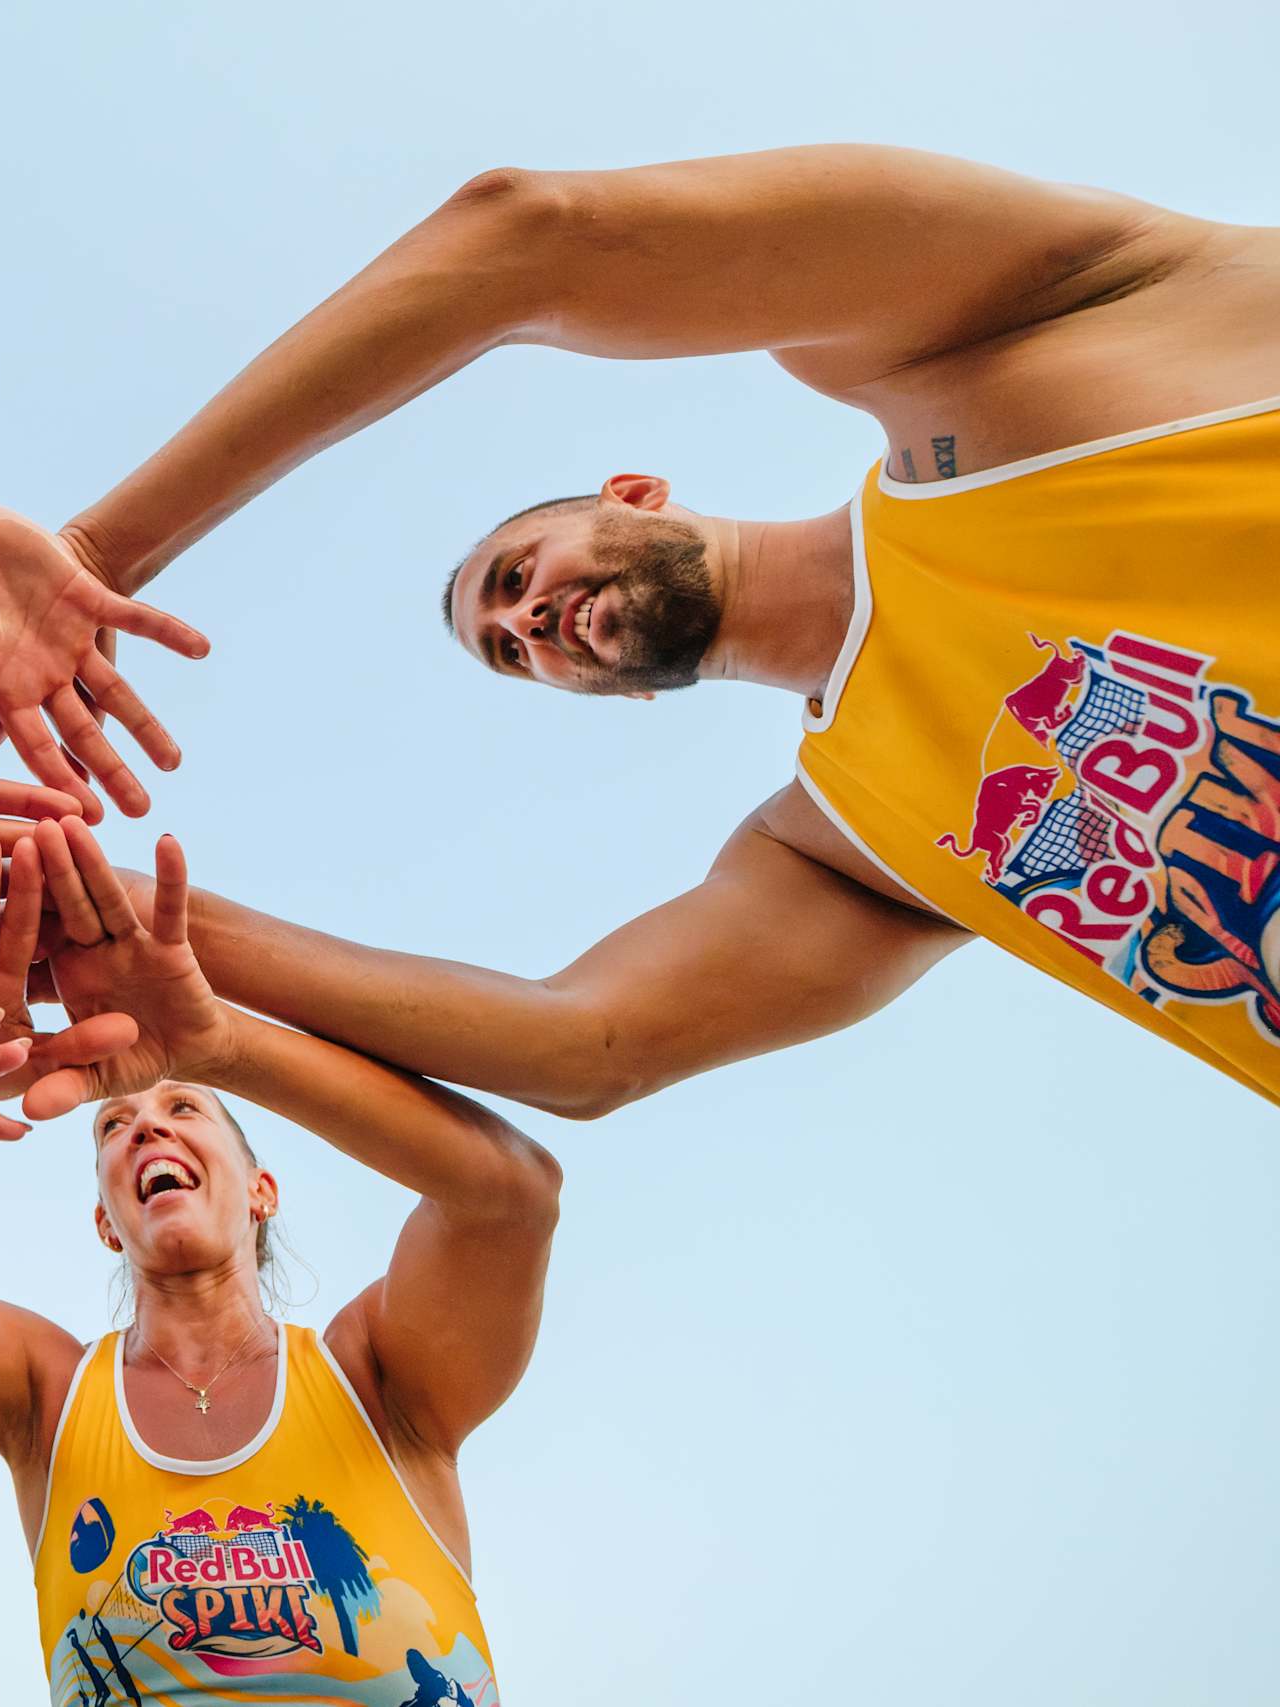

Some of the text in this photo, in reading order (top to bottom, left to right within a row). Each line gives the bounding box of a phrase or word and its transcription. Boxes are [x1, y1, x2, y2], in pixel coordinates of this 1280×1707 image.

[1024, 635, 1206, 967] Red Bull
[149, 1542, 311, 1583] Red Bull
[162, 1586, 322, 1653] SPIKE
